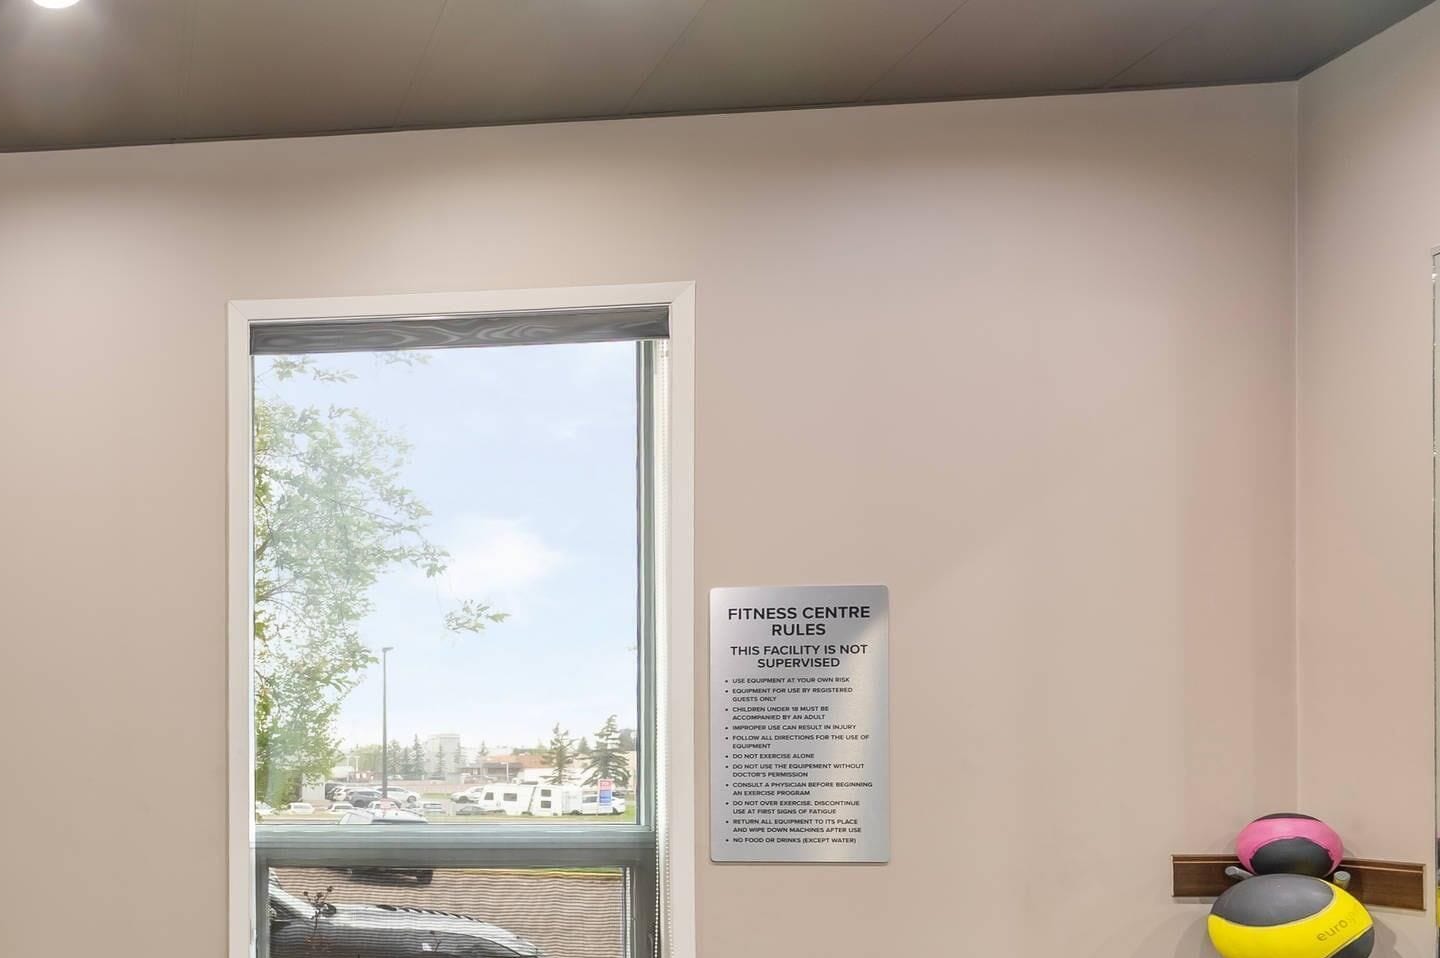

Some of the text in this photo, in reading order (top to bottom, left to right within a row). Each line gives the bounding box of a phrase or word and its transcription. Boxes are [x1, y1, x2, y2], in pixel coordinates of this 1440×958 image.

[728, 606, 870, 620] FITNESS CENTRE
[772, 624, 826, 636] RULES
[730, 644, 868, 655] THIS FACILITY IS NOT
[757, 658, 840, 668] SUPERVISED
